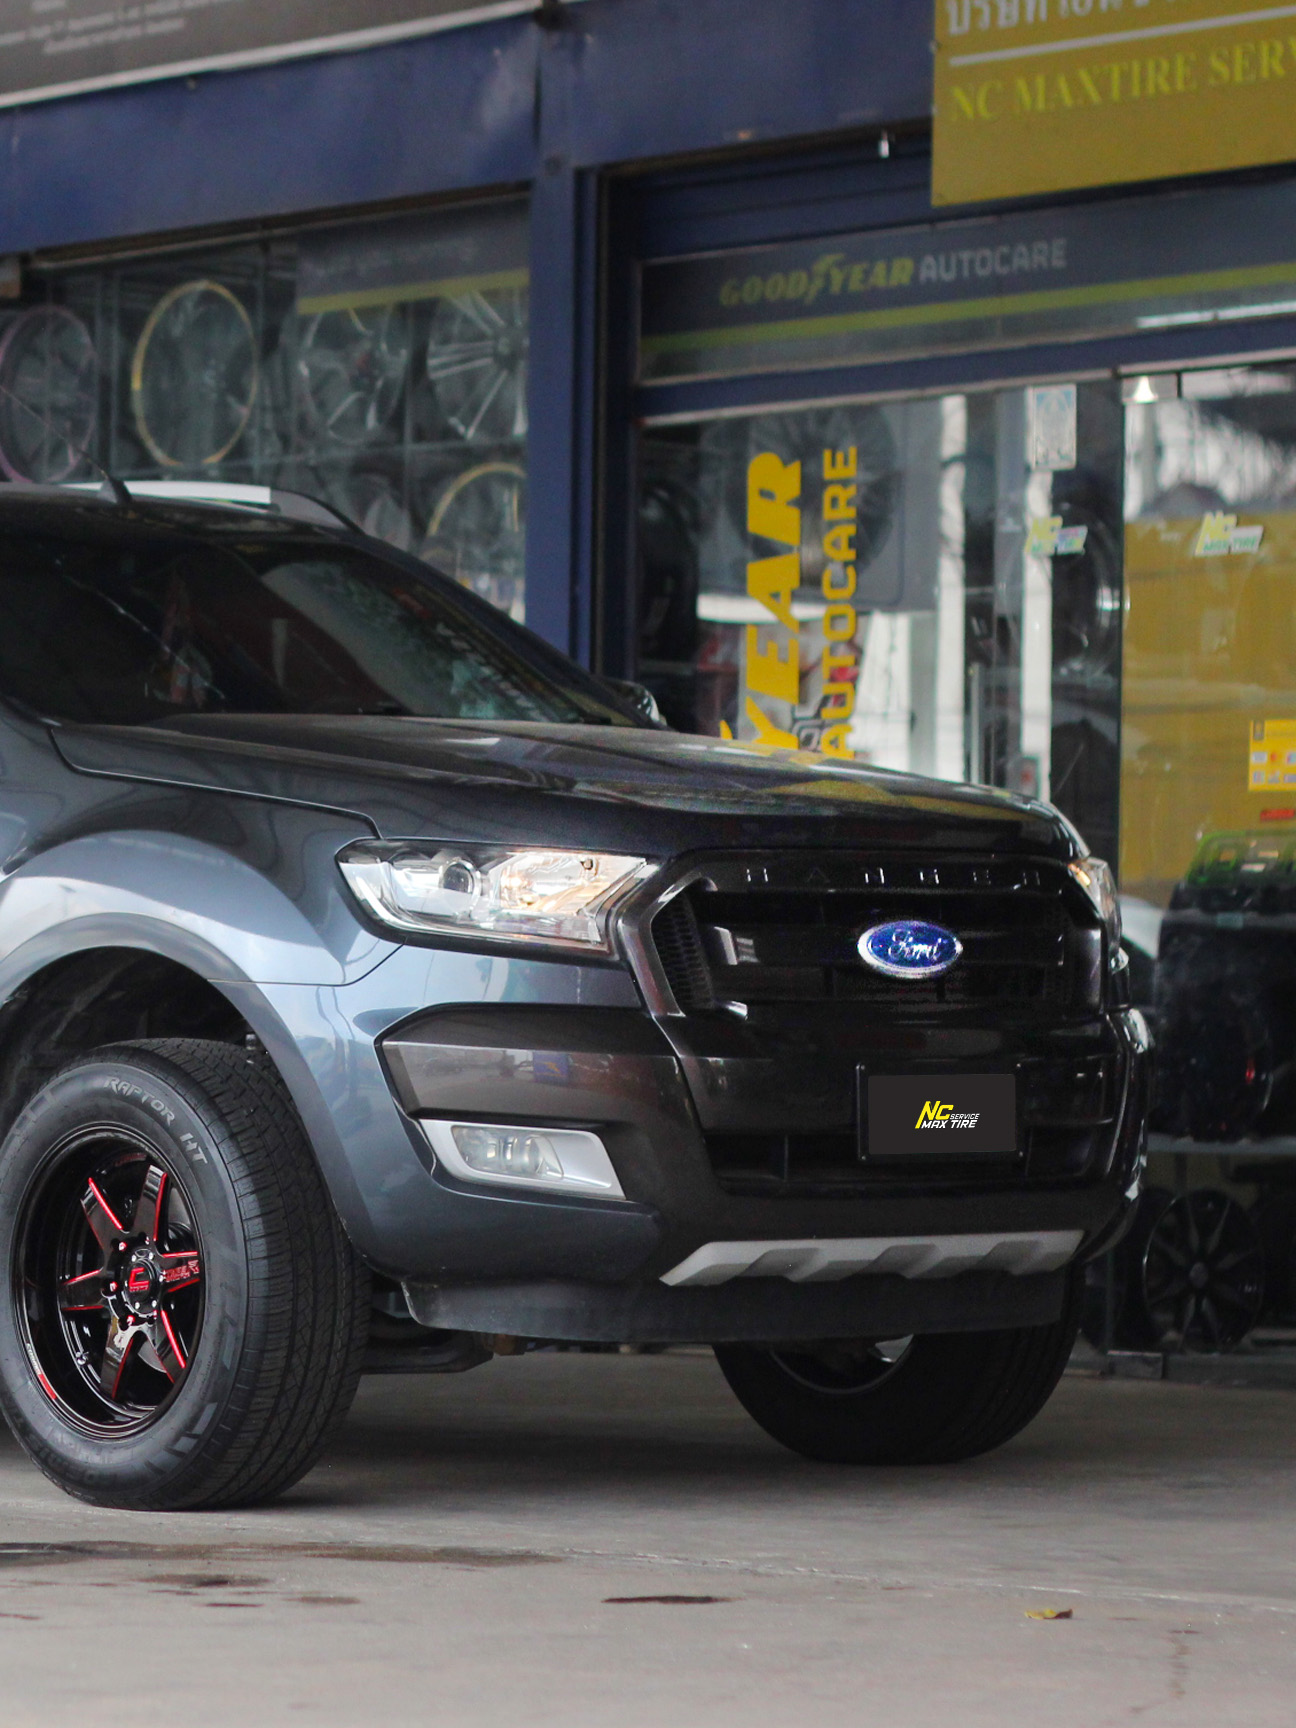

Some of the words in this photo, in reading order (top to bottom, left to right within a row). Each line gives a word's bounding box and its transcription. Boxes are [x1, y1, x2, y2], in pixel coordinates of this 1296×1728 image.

[950, 79, 1003, 123] NC
[1016, 50, 1198, 113] MAXTIRE
[719, 253, 915, 307] GOODYEAR
[918, 238, 1068, 285] AUTOCARE
[819, 446, 858, 759] AUTOCARE
[104, 1076, 176, 1127] RAPTOR
